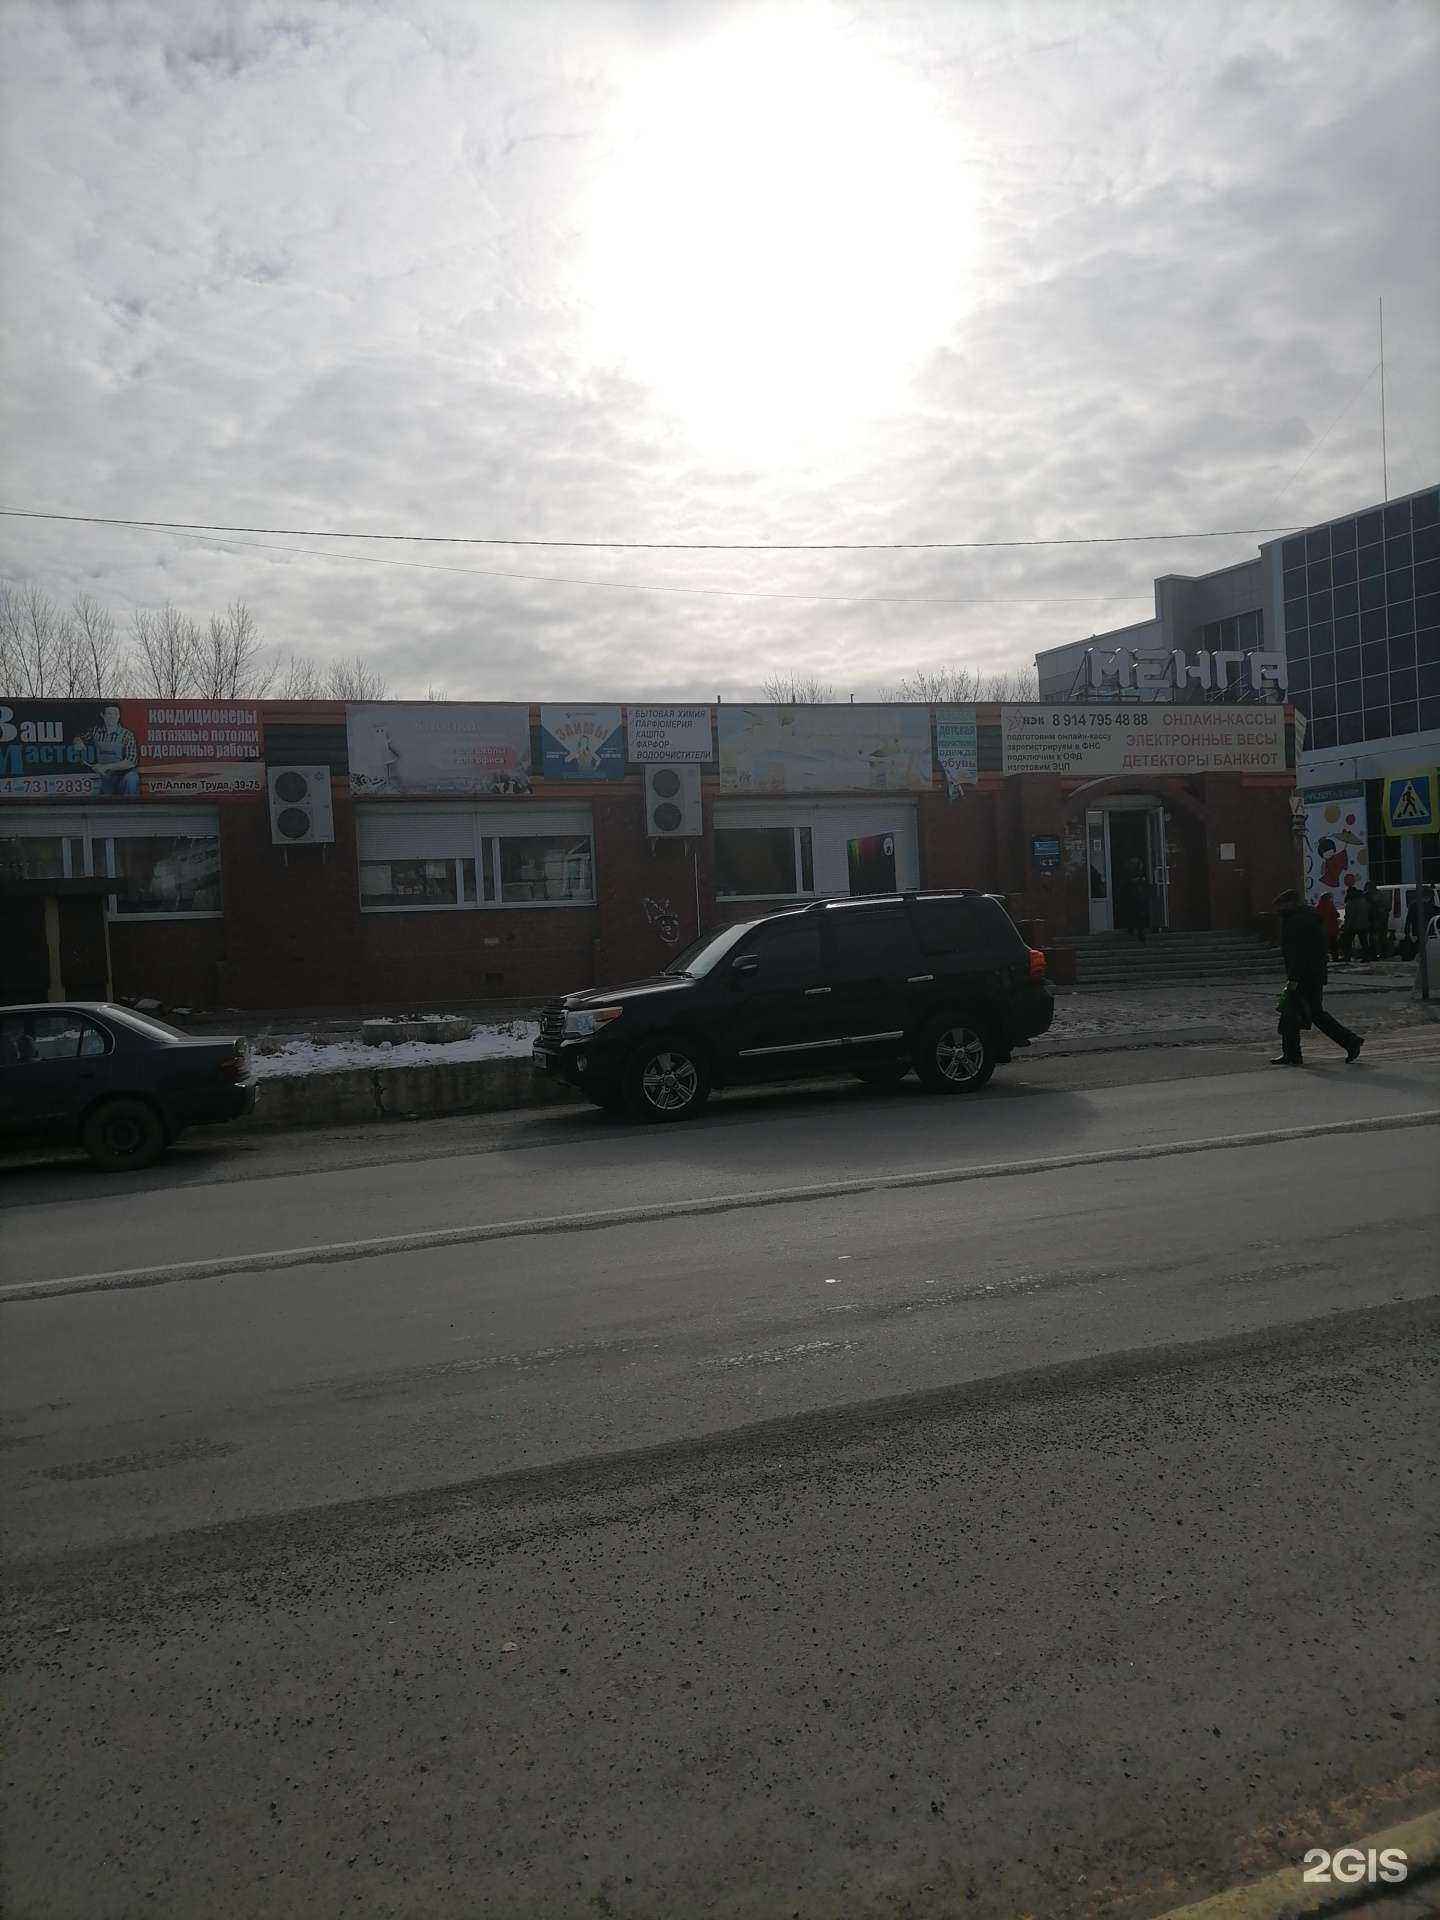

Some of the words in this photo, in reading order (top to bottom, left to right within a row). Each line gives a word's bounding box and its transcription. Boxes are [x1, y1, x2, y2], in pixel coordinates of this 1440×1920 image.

[635, 708, 675, 718] БЫТОВАЯ
[676, 708, 706, 718] ХИМИЯ
[1162, 711, 1277, 726] ОНЛАЙН-КАССЫ
[1052, 713, 1061, 726] 8
[1063, 713, 1087, 726] 914
[1089, 713, 1112, 726] 795
[1115, 713, 1131, 726] 48
[1133, 713, 1149, 726] 88
[211, 729, 259, 742] потолки
[635, 730, 665, 739] КАШПО
[1126, 733, 1233, 747] ЭЛЕКТРОННЫЕ
[1237, 732, 1278, 746] ВЕСЫ
[140, 744, 215, 758] отделочные
[216, 743, 260, 758] работы
[636, 741, 670, 750] ФАРФОР
[1081, 742, 1101, 750] ФНС
[636, 751, 711, 760] ВОДООЧИСТИТЕЛИ
[1063, 752, 1083, 761] ОФД
[1122, 754, 1209, 769] ДЕТЕКТОРЫ
[1213, 752, 1279, 767] БАНКНОТ
[1052, 762, 1072, 772] ЭЦП
[24, 781, 49, 793] 731
[56, 780, 92, 793] 2839
